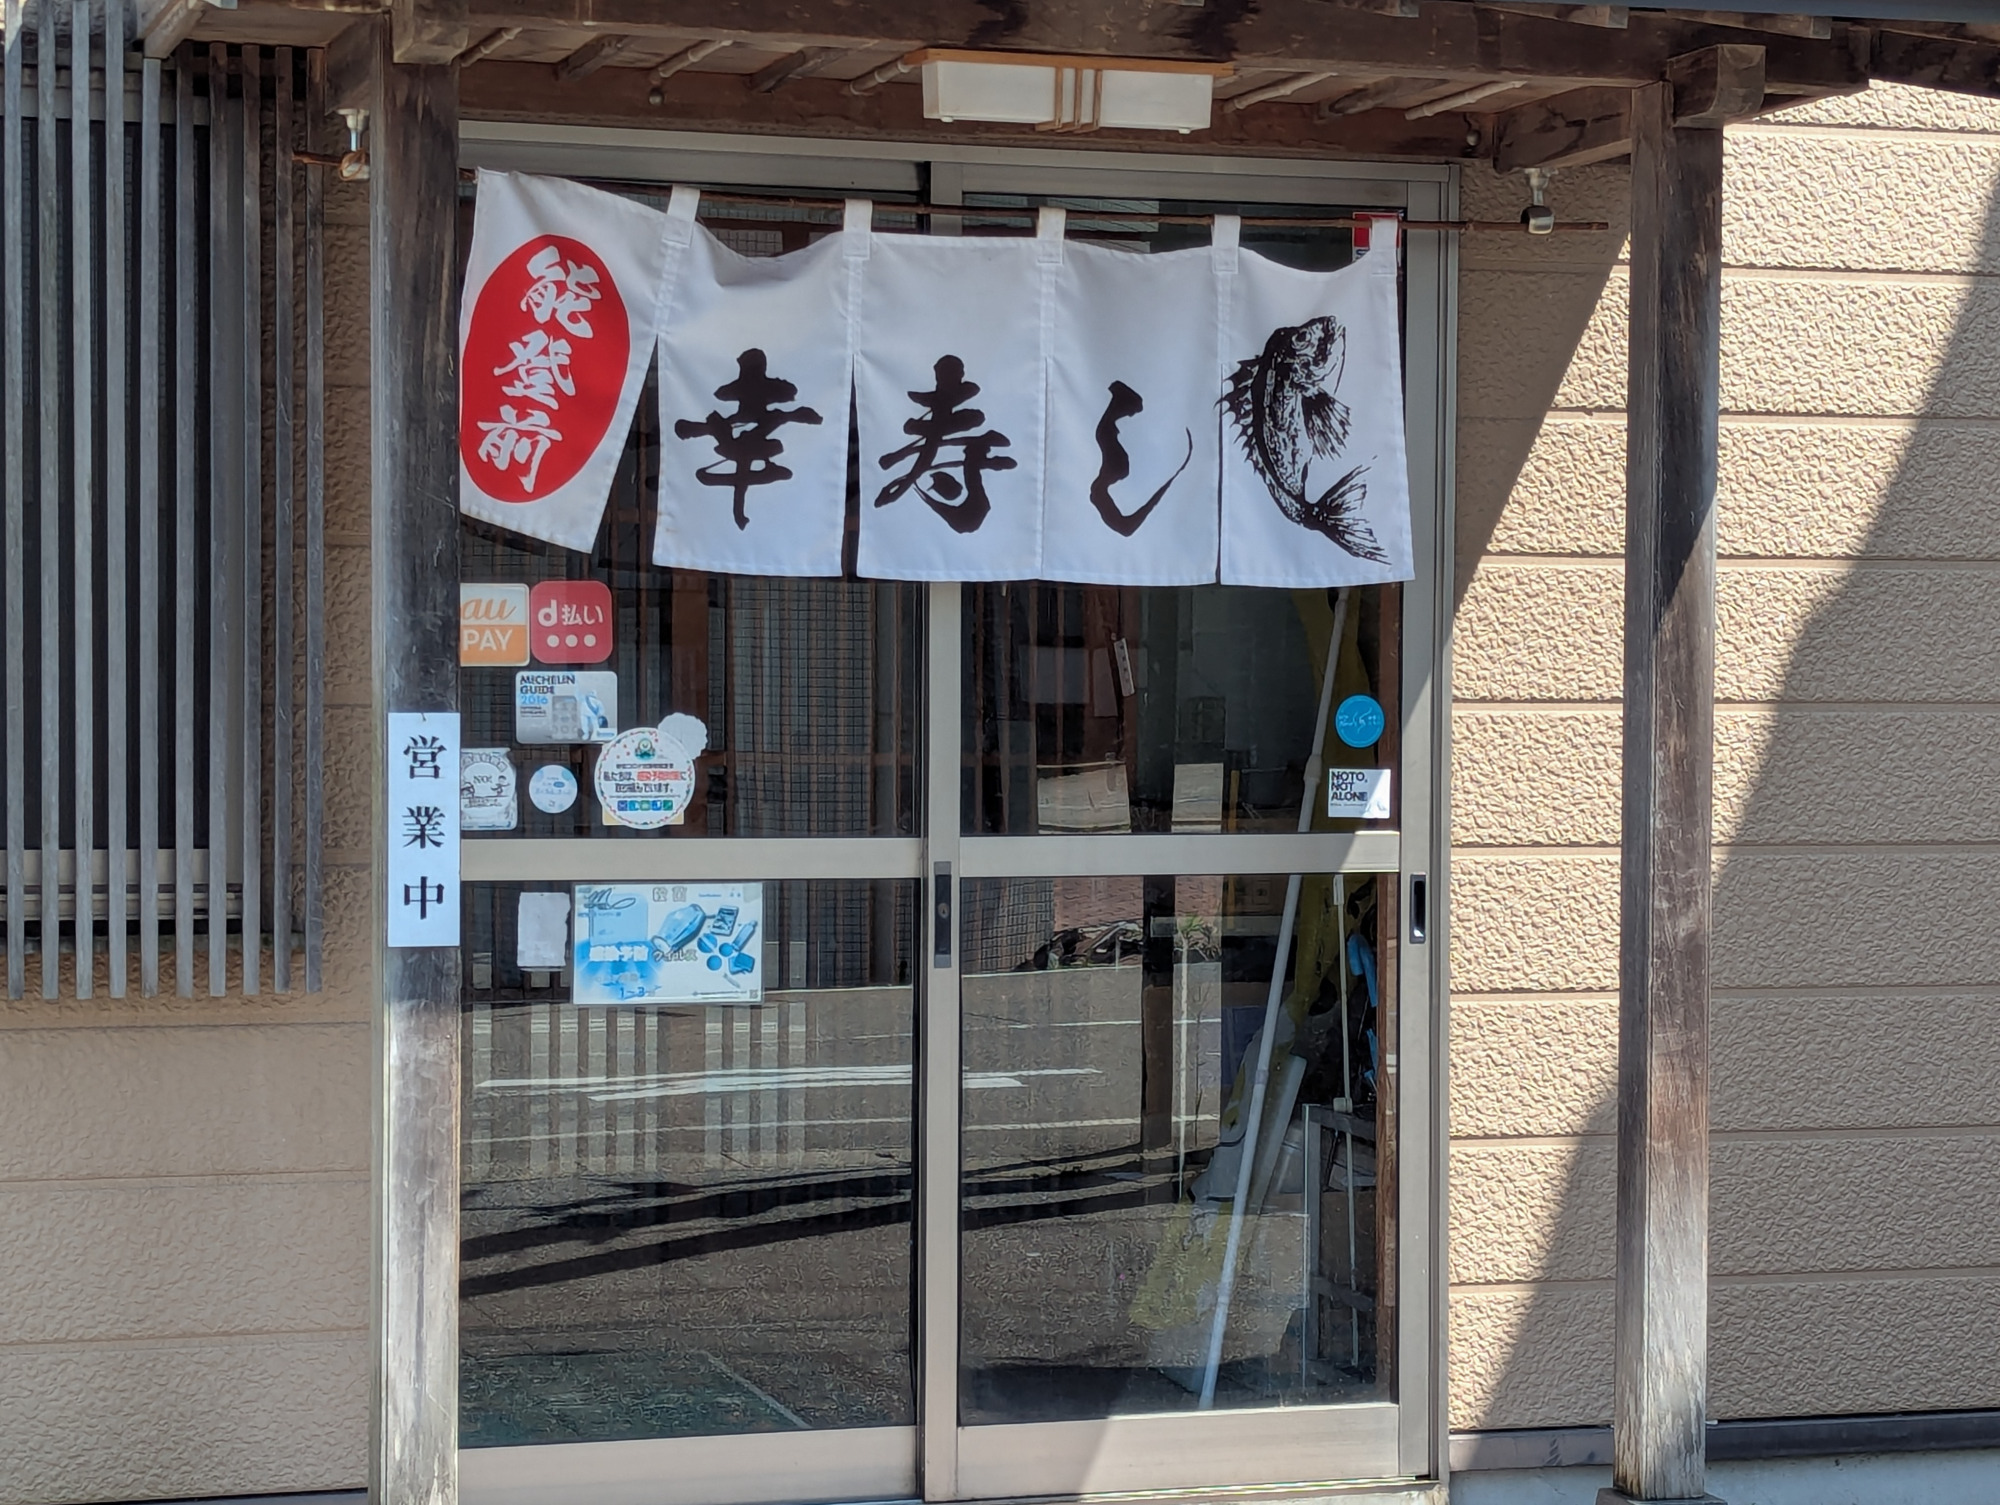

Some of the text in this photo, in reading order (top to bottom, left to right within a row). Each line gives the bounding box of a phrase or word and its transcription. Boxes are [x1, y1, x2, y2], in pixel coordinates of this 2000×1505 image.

[476, 244, 602, 493] 能登前
[674, 347, 1194, 538] 幸寿し
[462, 597, 517, 621] au
[537, 598, 605, 627] d払い
[462, 629, 513, 651] PAY
[519, 674, 576, 685] MICHELIN
[519, 685, 555, 694] GUIDE
[520, 695, 549, 705] 2016
[1331, 781, 1355, 791] NOT
[1331, 791, 1368, 802] ALONE
[401, 734, 448, 921] 営業中
